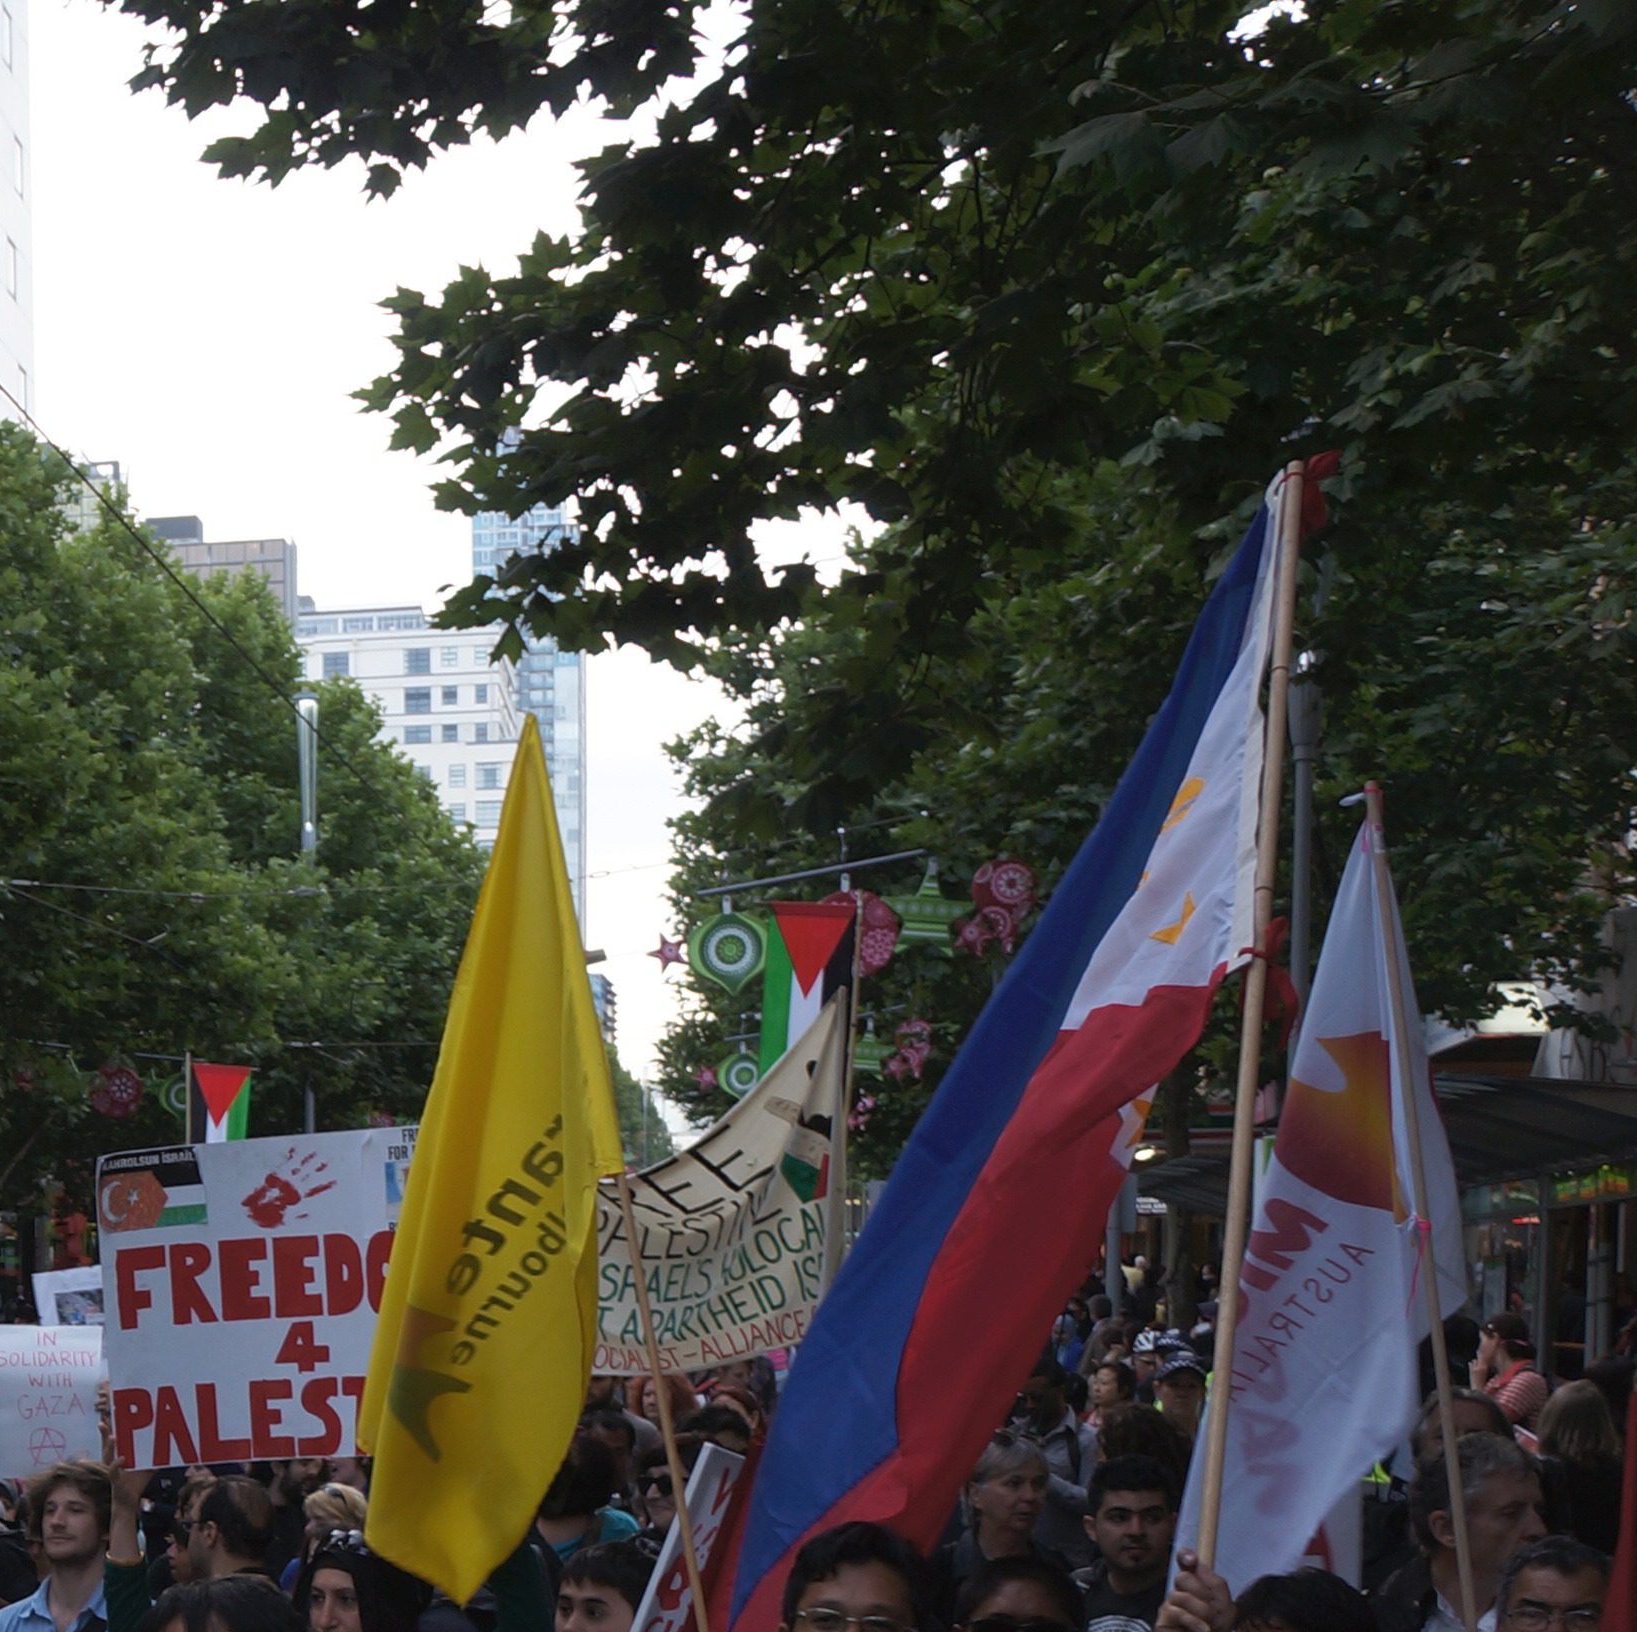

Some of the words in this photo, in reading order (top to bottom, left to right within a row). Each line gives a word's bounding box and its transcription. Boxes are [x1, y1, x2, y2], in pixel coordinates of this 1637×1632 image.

[116, 1231, 397, 1330] FREEDO
[37, 1332, 56, 1346] IN
[275, 1321, 329, 1374] 4
[28, 1373, 72, 1388] WITH
[18, 1394, 85, 1419] GAZA
[113, 1377, 367, 1469] PALEST
